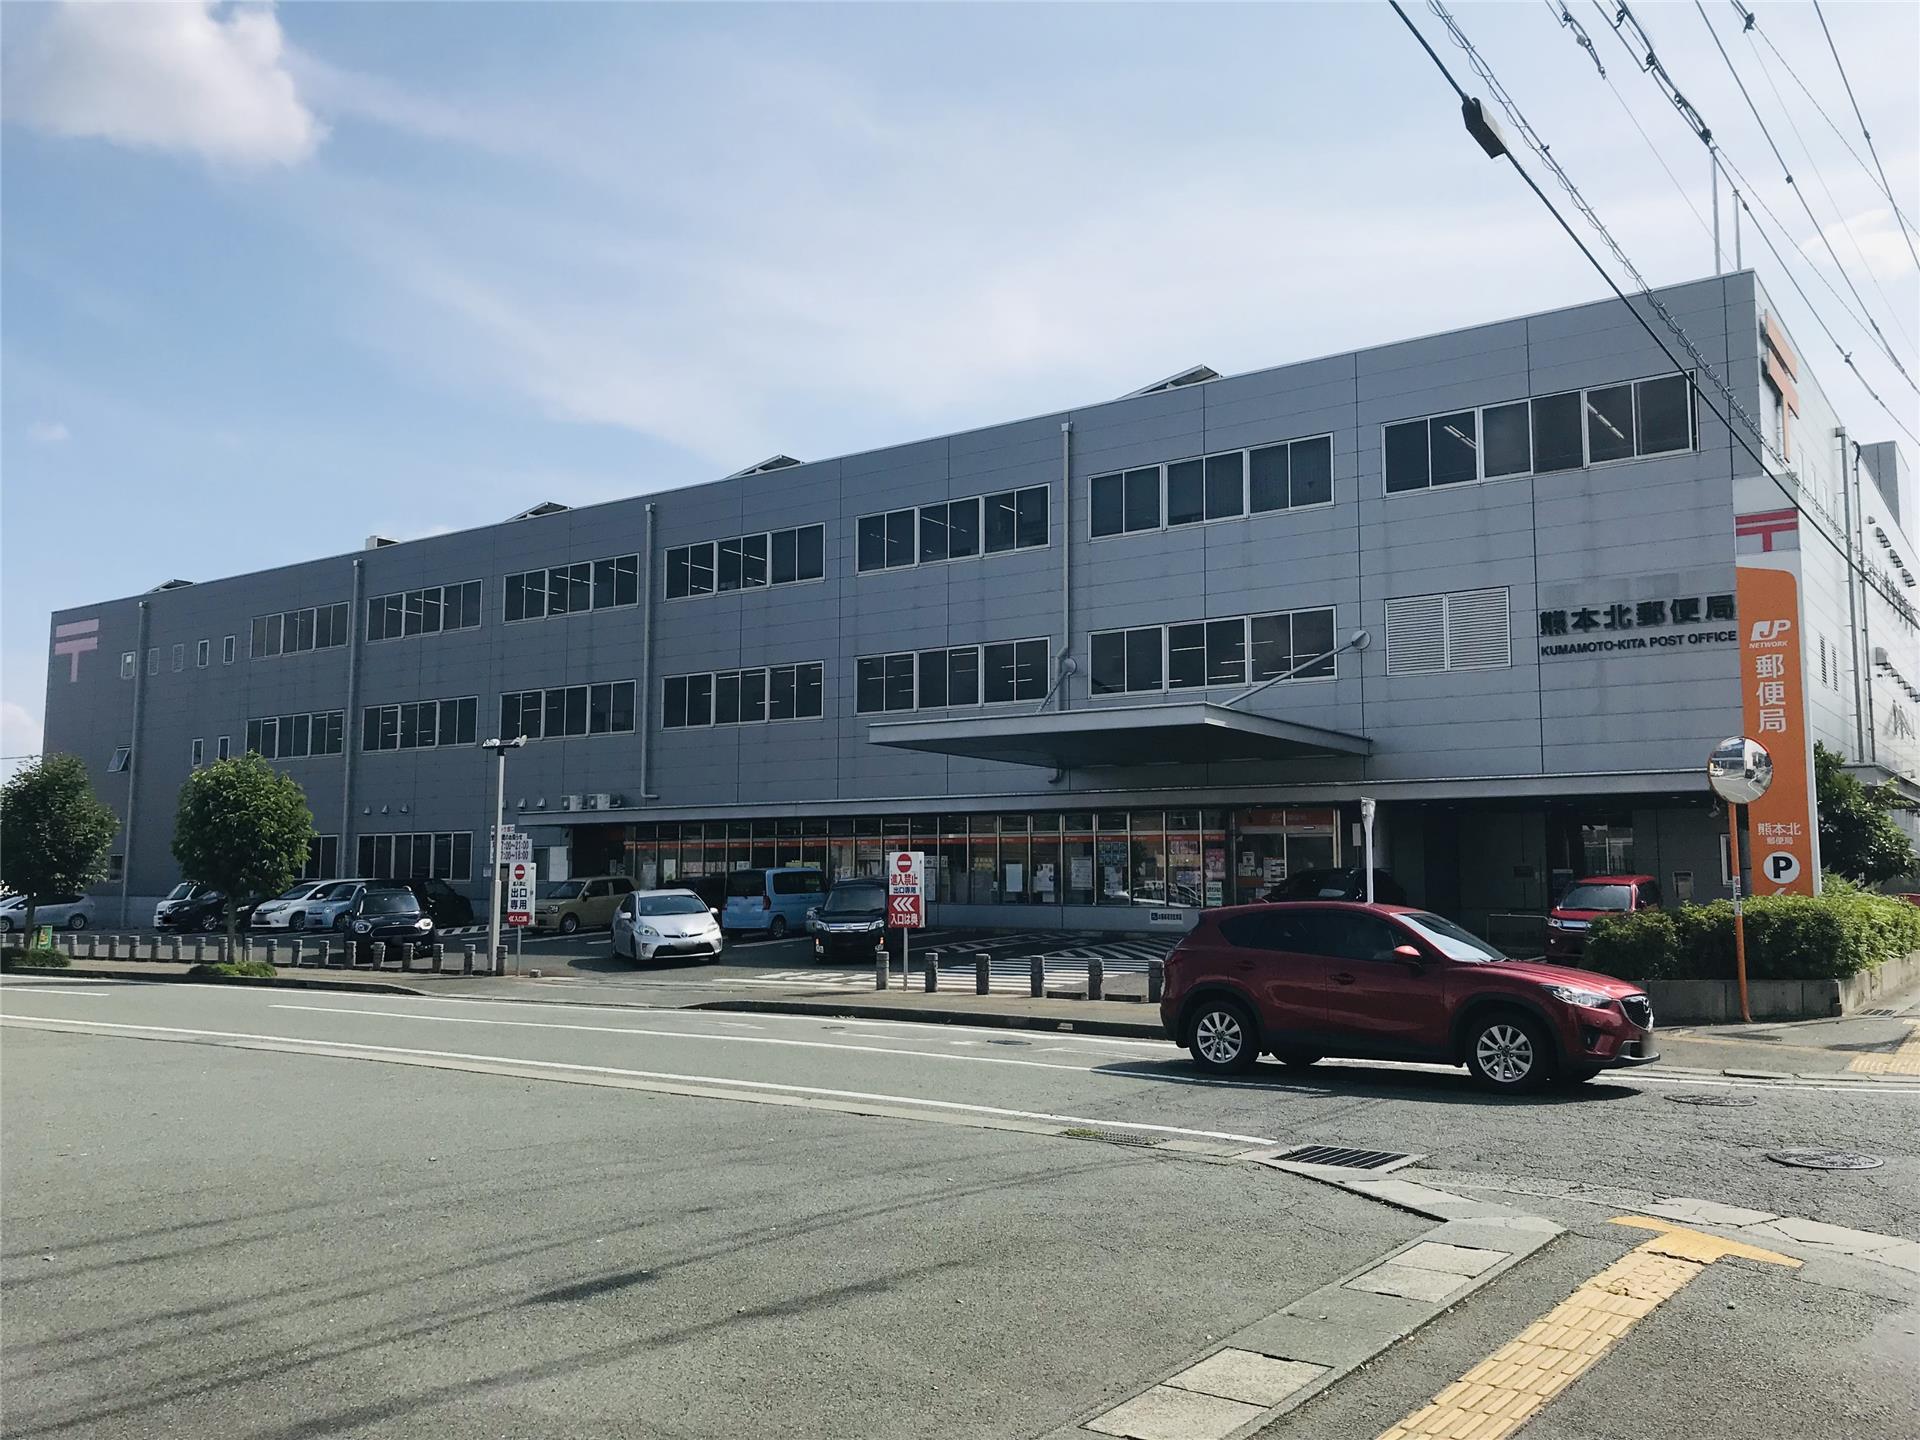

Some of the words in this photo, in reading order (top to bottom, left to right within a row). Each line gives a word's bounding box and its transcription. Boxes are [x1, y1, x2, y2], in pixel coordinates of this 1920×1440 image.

[1539, 595, 1735, 636] 熊本北郵便局
[1750, 619, 1791, 641] JP
[1541, 637, 1647, 657] KUMAMOTO-KITA
[1650, 634, 1685, 648] POST
[1688, 630, 1737, 645] OFFICE
[1749, 640, 1788, 649] NETWORK
[1755, 653, 1787, 734] 郵便局
[1757, 822, 1802, 836] 熊本北
[1773, 856, 1793, 879] P
[891, 874, 918, 886] 進入禁止
[511, 888, 527, 898] 出口
[511, 900, 527, 910] 専用
